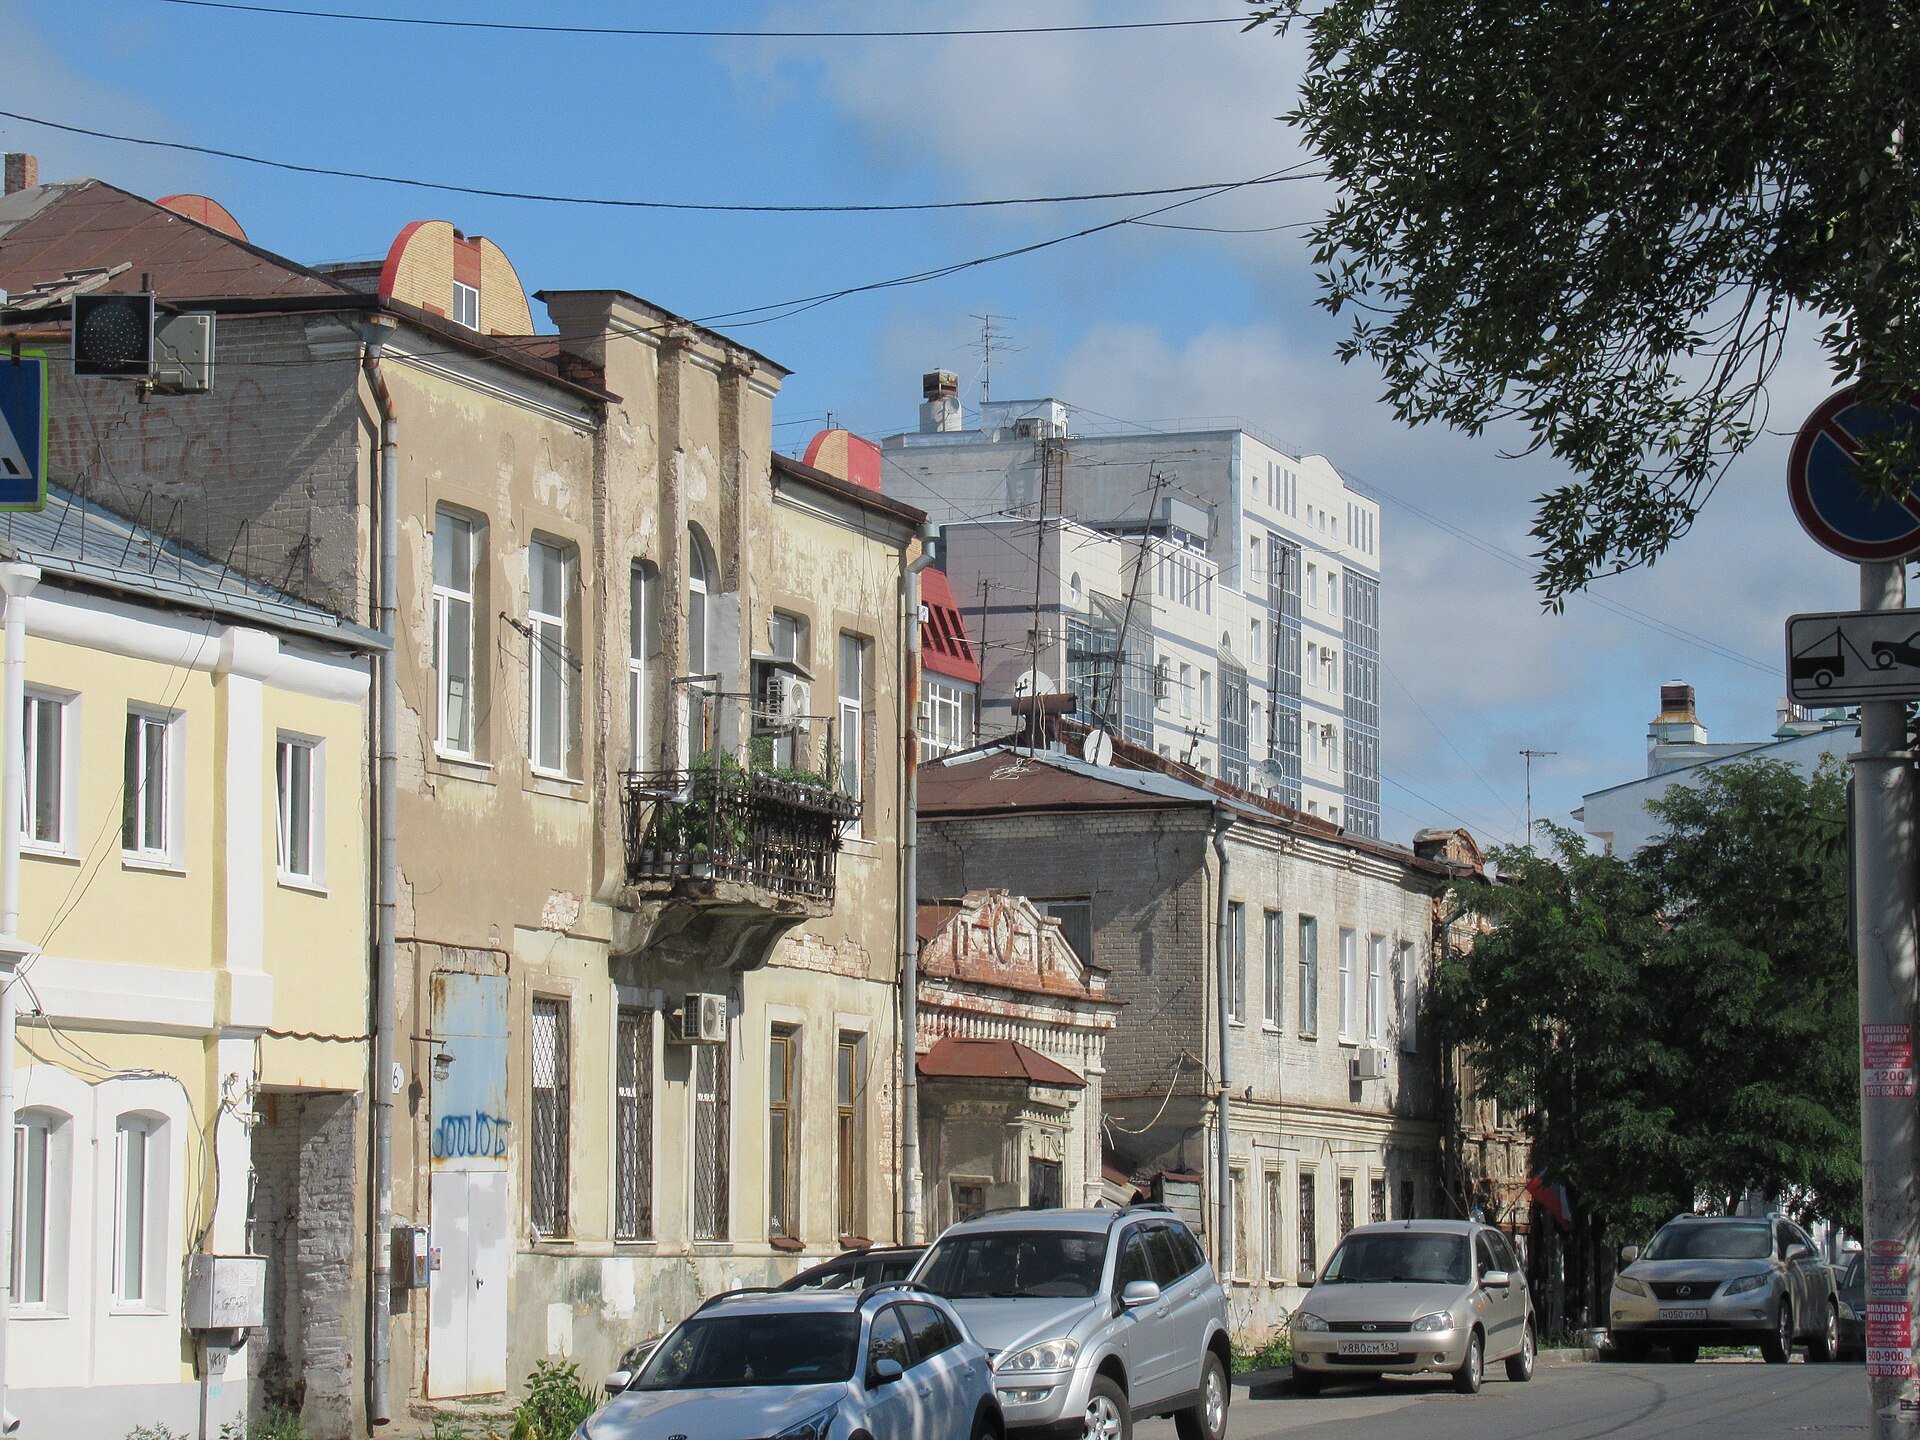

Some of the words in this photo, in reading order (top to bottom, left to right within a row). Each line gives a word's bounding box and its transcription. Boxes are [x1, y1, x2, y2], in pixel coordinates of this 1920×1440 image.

[392, 1067, 399, 1088] 6
[1874, 1070, 1905, 1081] 1200
[1868, 1313, 1905, 1322] ЛЮДЯМ
[1381, 1342, 1396, 1351] 163
